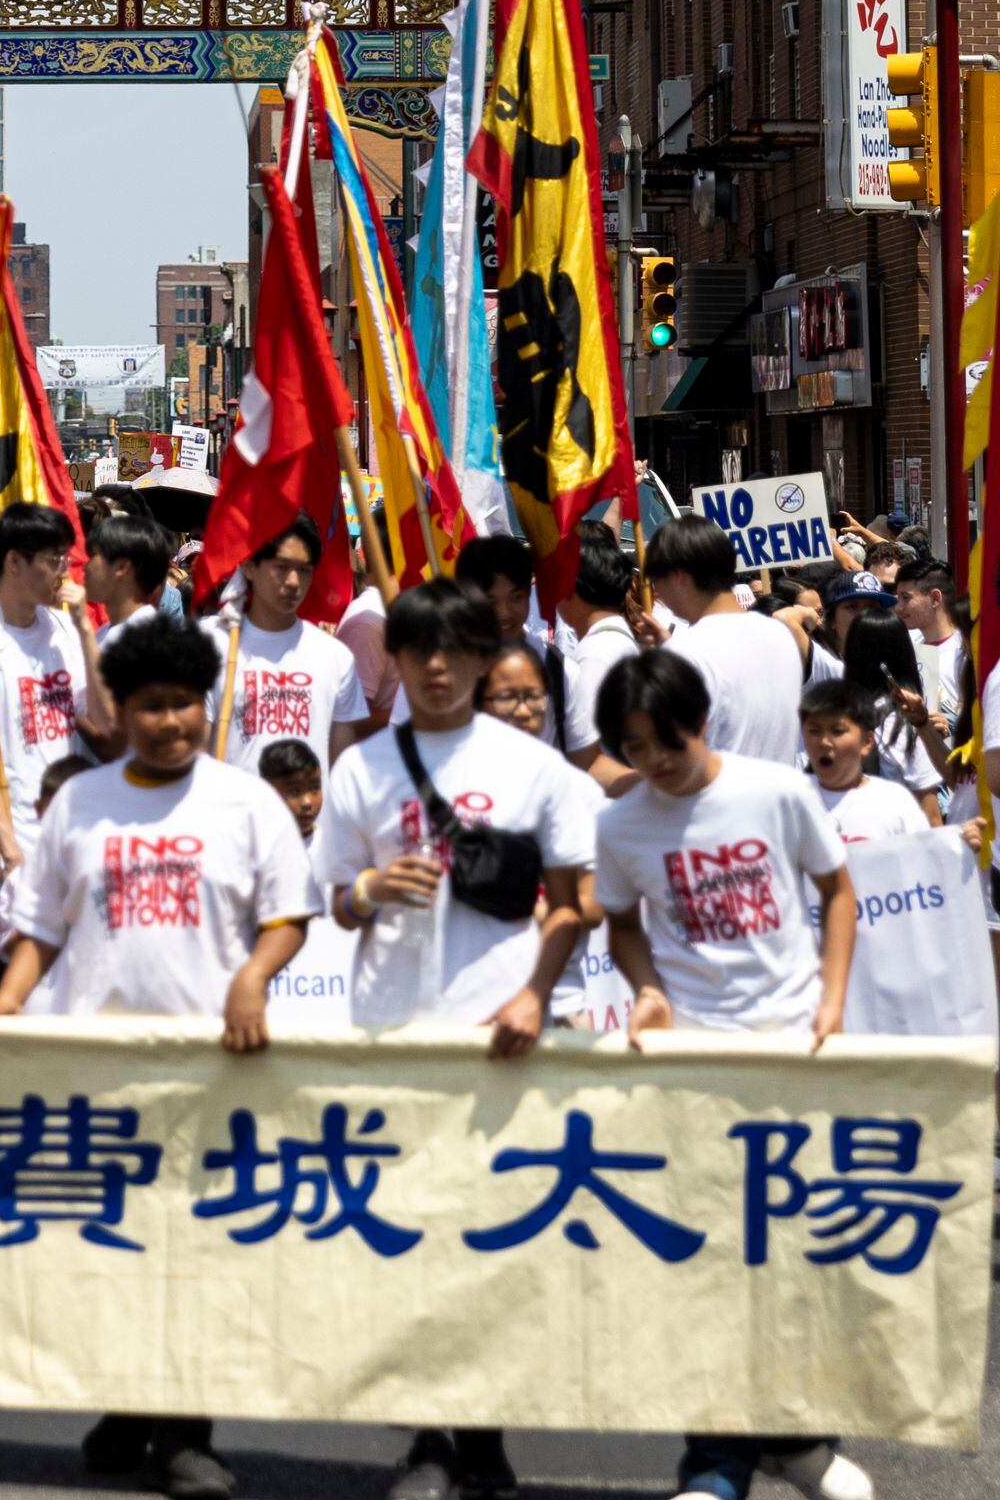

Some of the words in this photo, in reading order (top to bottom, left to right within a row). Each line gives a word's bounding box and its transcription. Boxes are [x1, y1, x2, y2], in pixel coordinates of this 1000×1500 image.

[859, 78, 874, 100] Lan
[858, 105, 888, 128] Hand-Pu
[862, 134, 898, 158] Noodles
[858, 164, 890, 196] 215-982-
[701, 488, 754, 530] NO
[728, 517, 832, 568] ARENA
[261, 671, 312, 687] NO
[259, 702, 309, 719] CHINA
[258, 719, 310, 737] TOWN
[129, 835, 203, 857] NO
[689, 838, 768, 871] NO
[125, 877, 200, 904] CHINA
[698, 883, 779, 920] CHINA
[127, 901, 200, 928] TOWN
[704, 913, 781, 942] TOWN
[273, 964, 345, 997] rican
